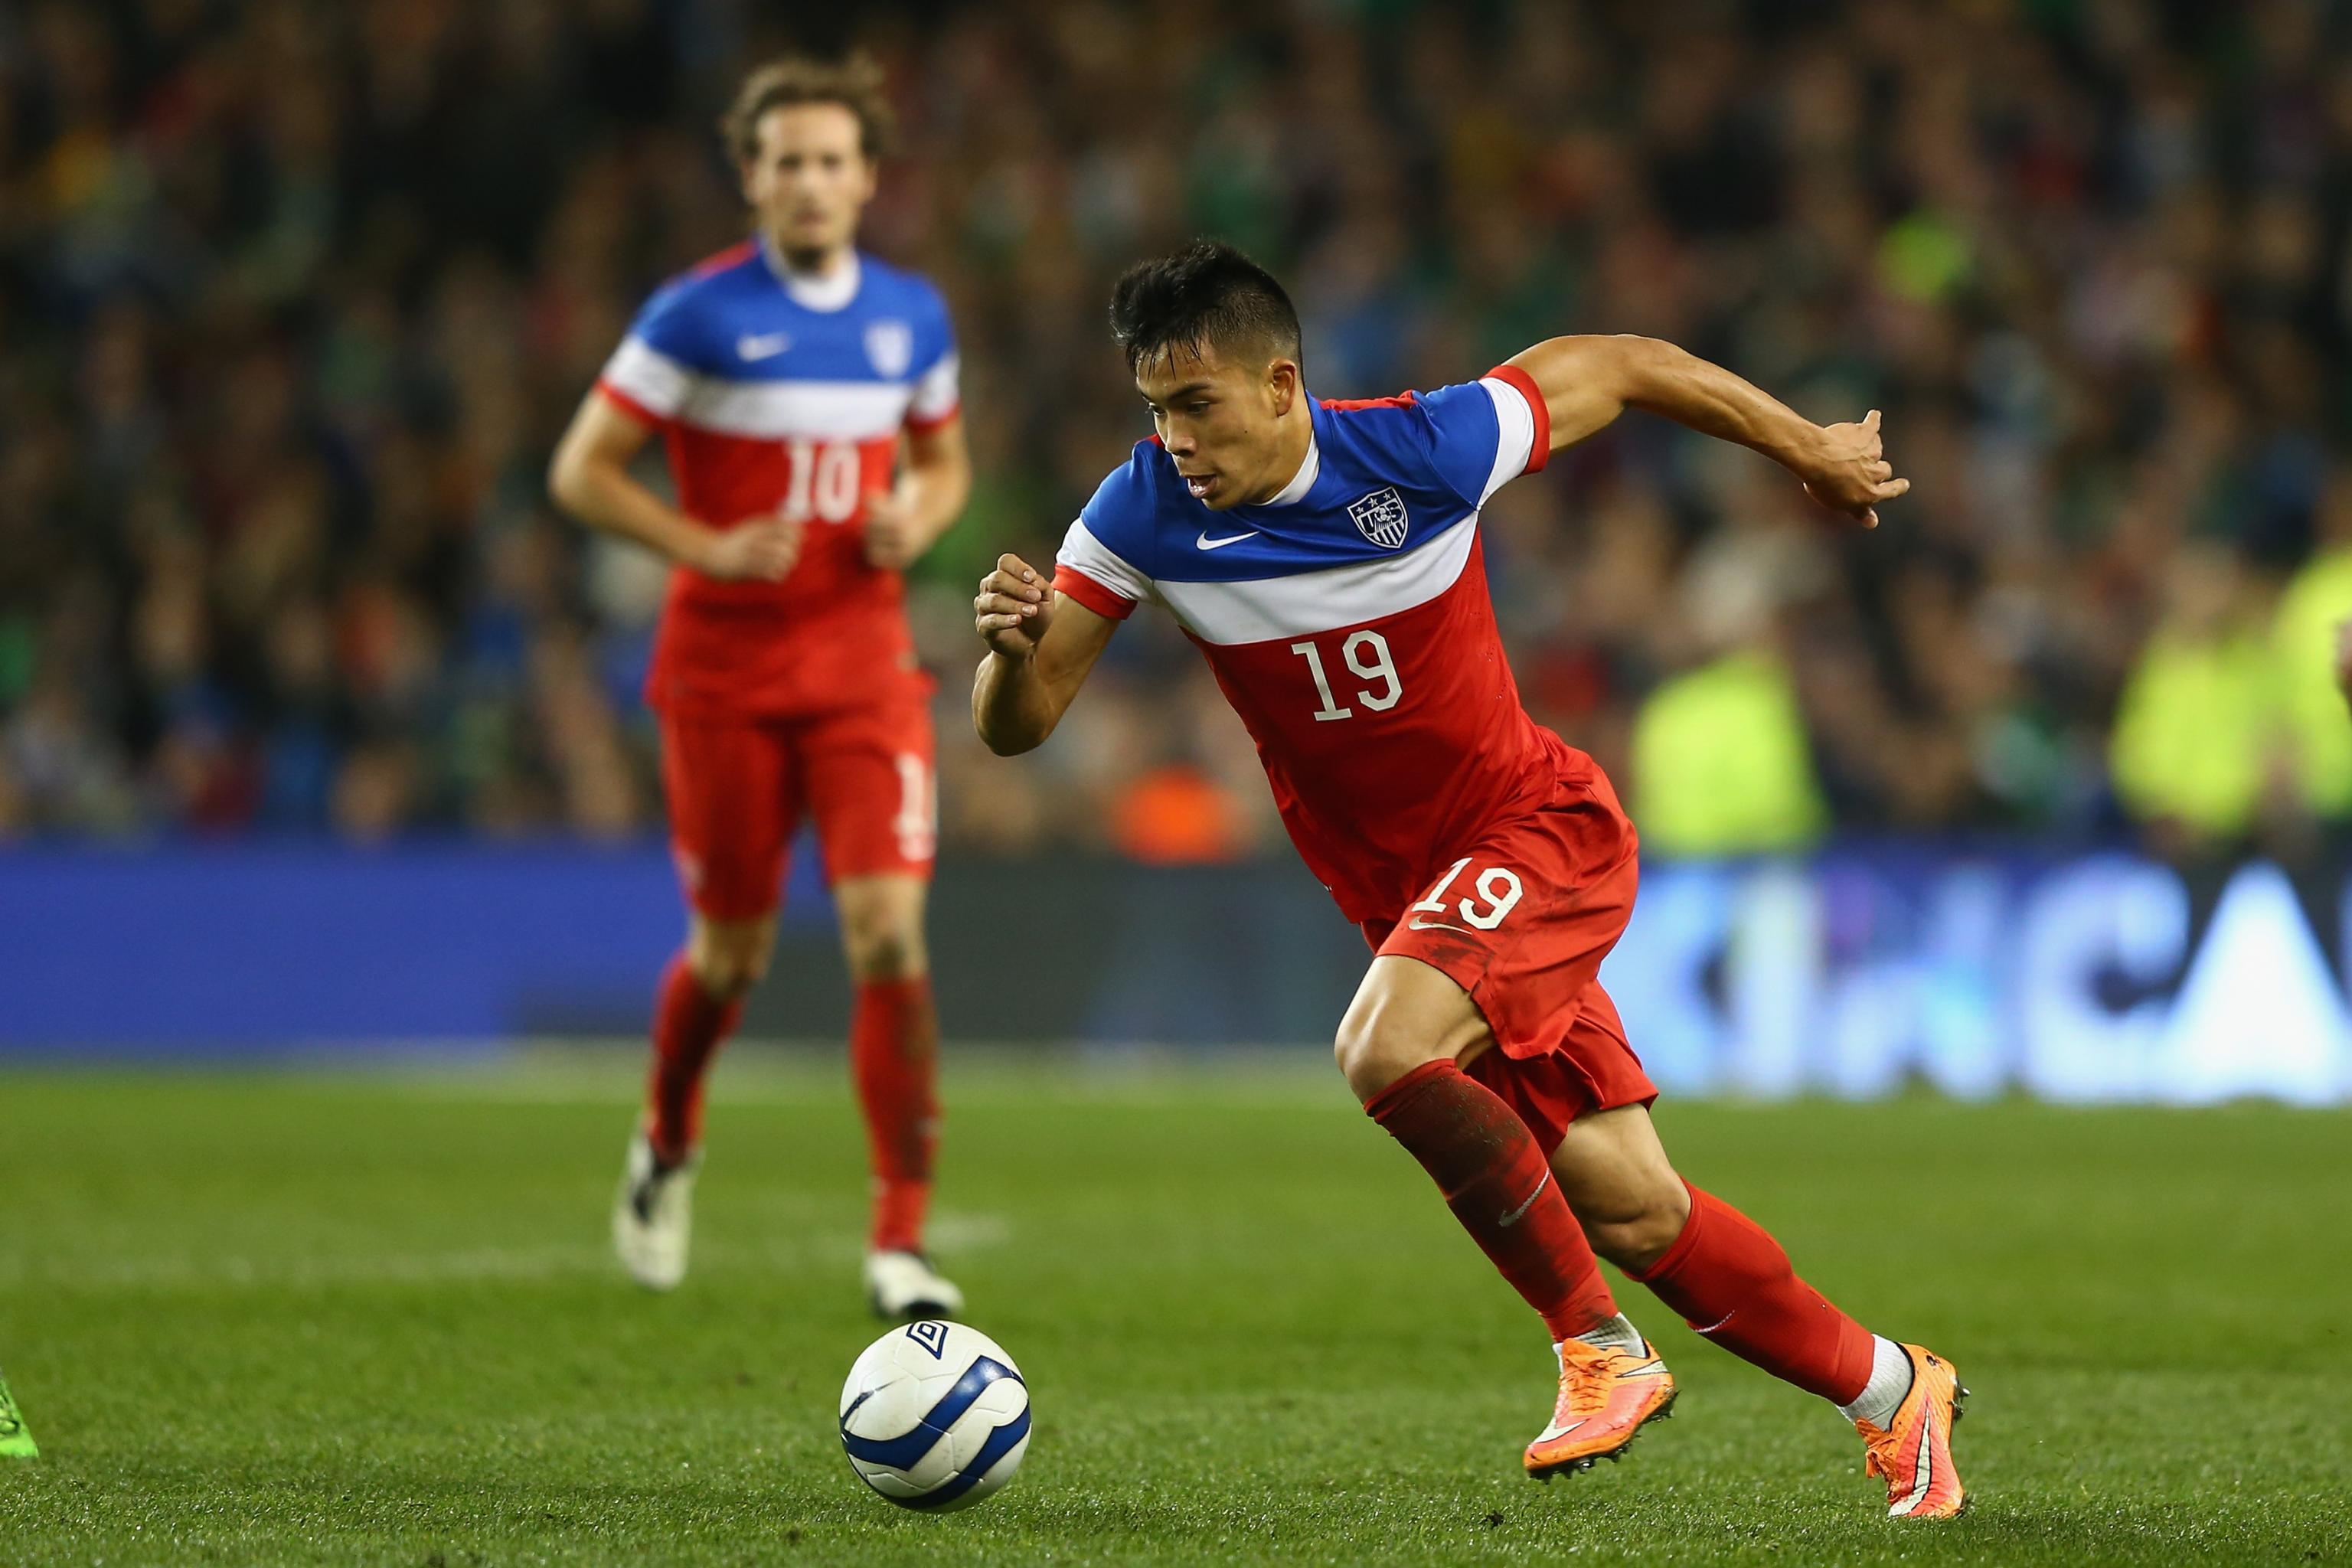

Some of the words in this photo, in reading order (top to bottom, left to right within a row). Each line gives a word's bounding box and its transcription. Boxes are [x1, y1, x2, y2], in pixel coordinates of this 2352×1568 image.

[782, 441, 861, 522] 10
[1291, 629, 1403, 721] 19
[1411, 857, 1524, 929] 19
